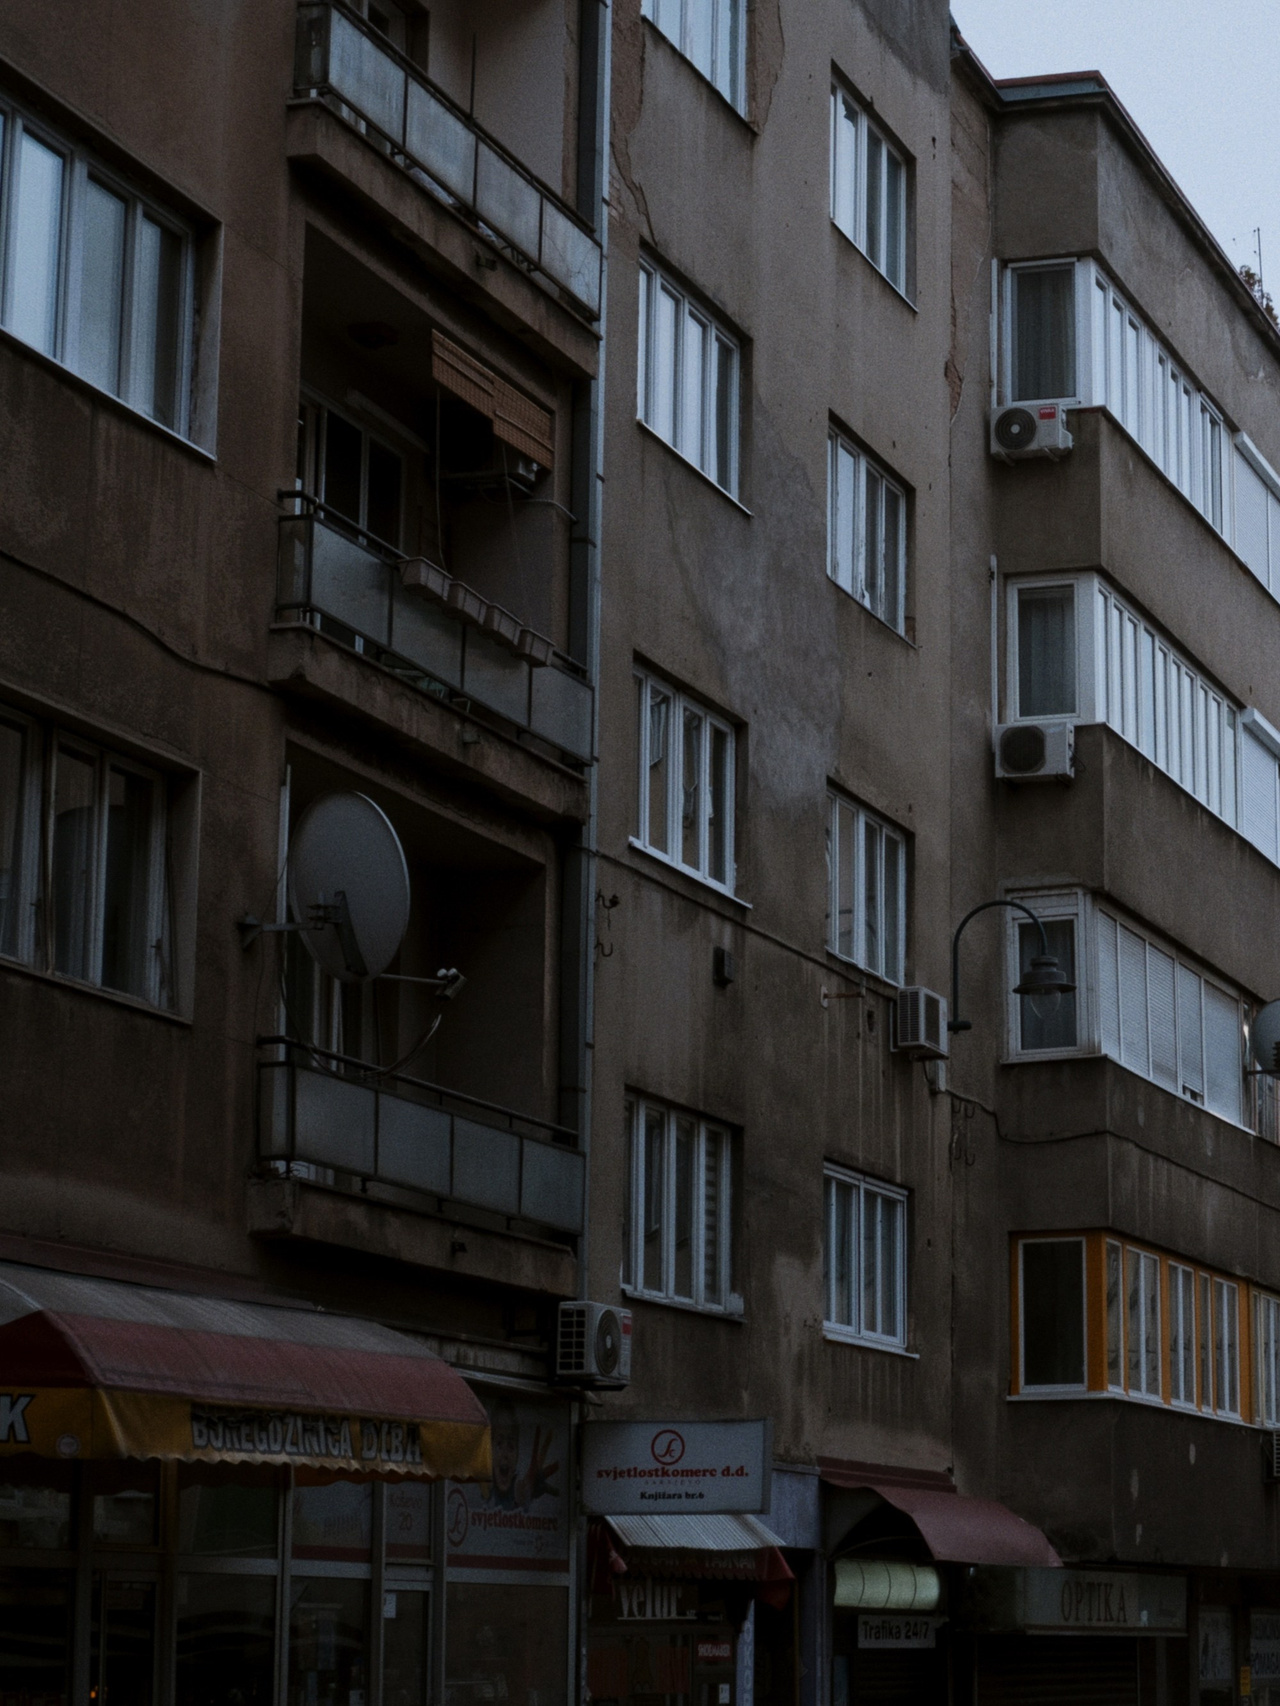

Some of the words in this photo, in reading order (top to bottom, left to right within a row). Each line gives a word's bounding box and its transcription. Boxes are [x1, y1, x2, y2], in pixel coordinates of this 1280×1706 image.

[597, 1466, 717, 1480] svjetlostkomerc
[721, 1466, 749, 1477] d.d.
[640, 1491, 683, 1502] Knjižara
[471, 1508, 560, 1533] svjetlostkomerc
[1061, 1580, 1127, 1623] OPTIKA
[863, 1620, 901, 1640] Trafika
[904, 1621, 929, 1640] 24/7
